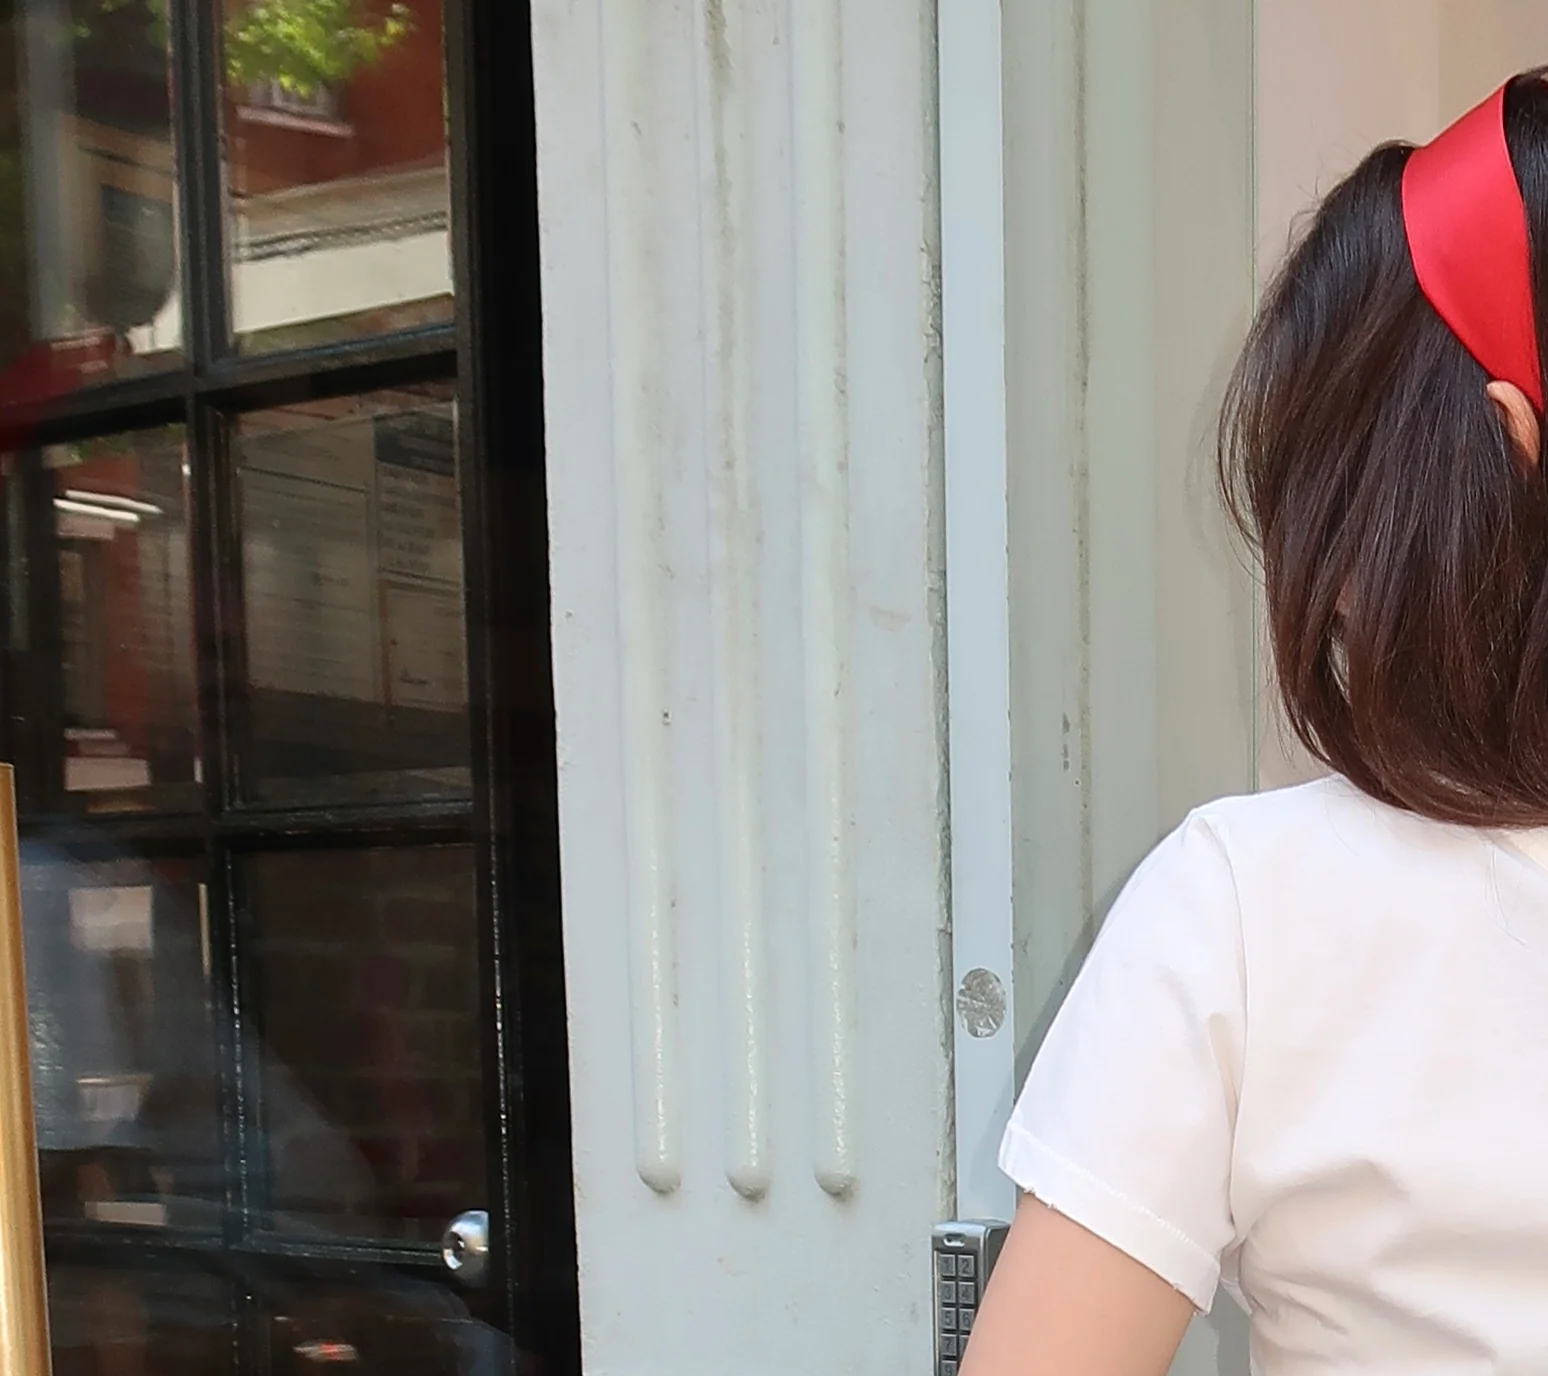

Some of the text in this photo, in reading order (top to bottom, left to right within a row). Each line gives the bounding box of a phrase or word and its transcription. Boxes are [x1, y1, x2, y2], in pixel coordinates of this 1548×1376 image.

[962, 1258, 971, 1273] 2
[944, 1285, 952, 1300] 3
[945, 1311, 971, 1327] 5 6
[944, 1337, 953, 1352] 7
